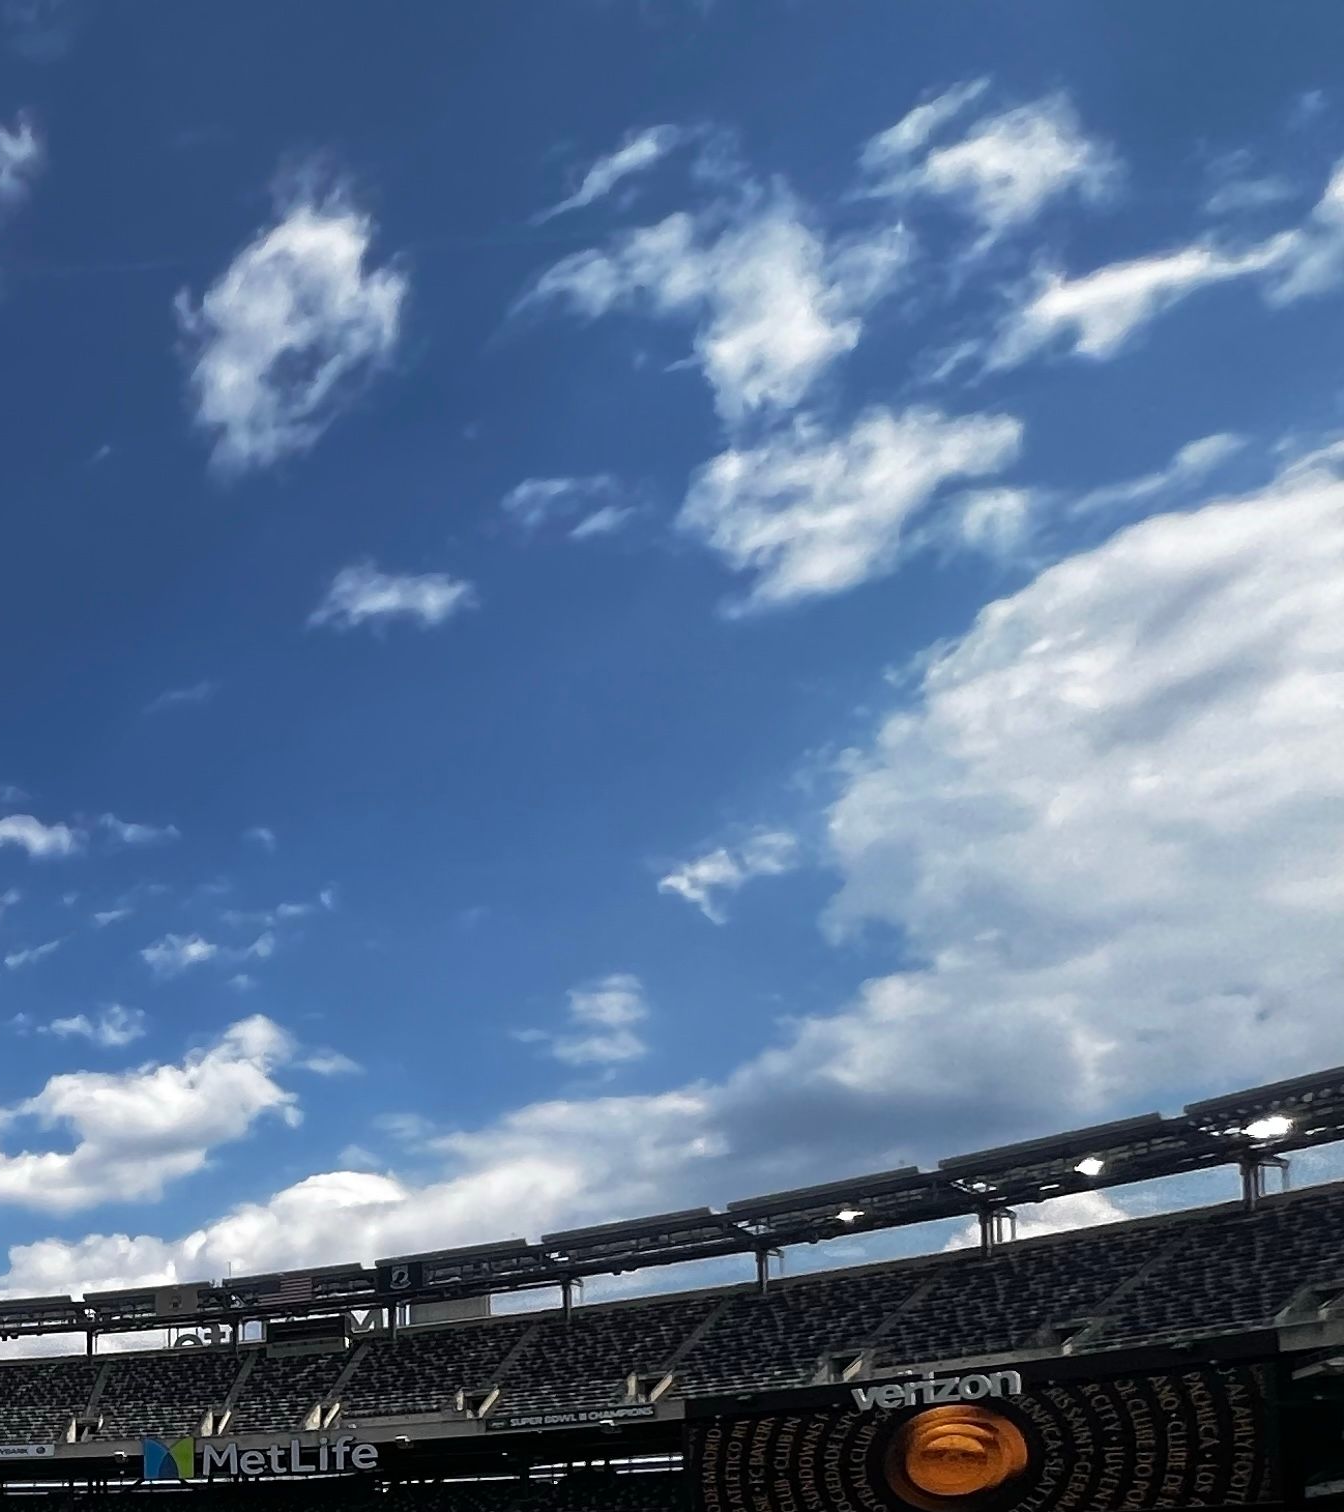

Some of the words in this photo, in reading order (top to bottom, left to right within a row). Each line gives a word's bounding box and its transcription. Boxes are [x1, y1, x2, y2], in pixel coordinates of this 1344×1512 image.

[850, 1369, 1023, 1411] verizon
[510, 1416, 543, 1427] SUPER
[544, 1413, 577, 1425] BOWL
[588, 1406, 654, 1421] CHAMPIONS
[202, 1434, 380, 1477] MetLife
